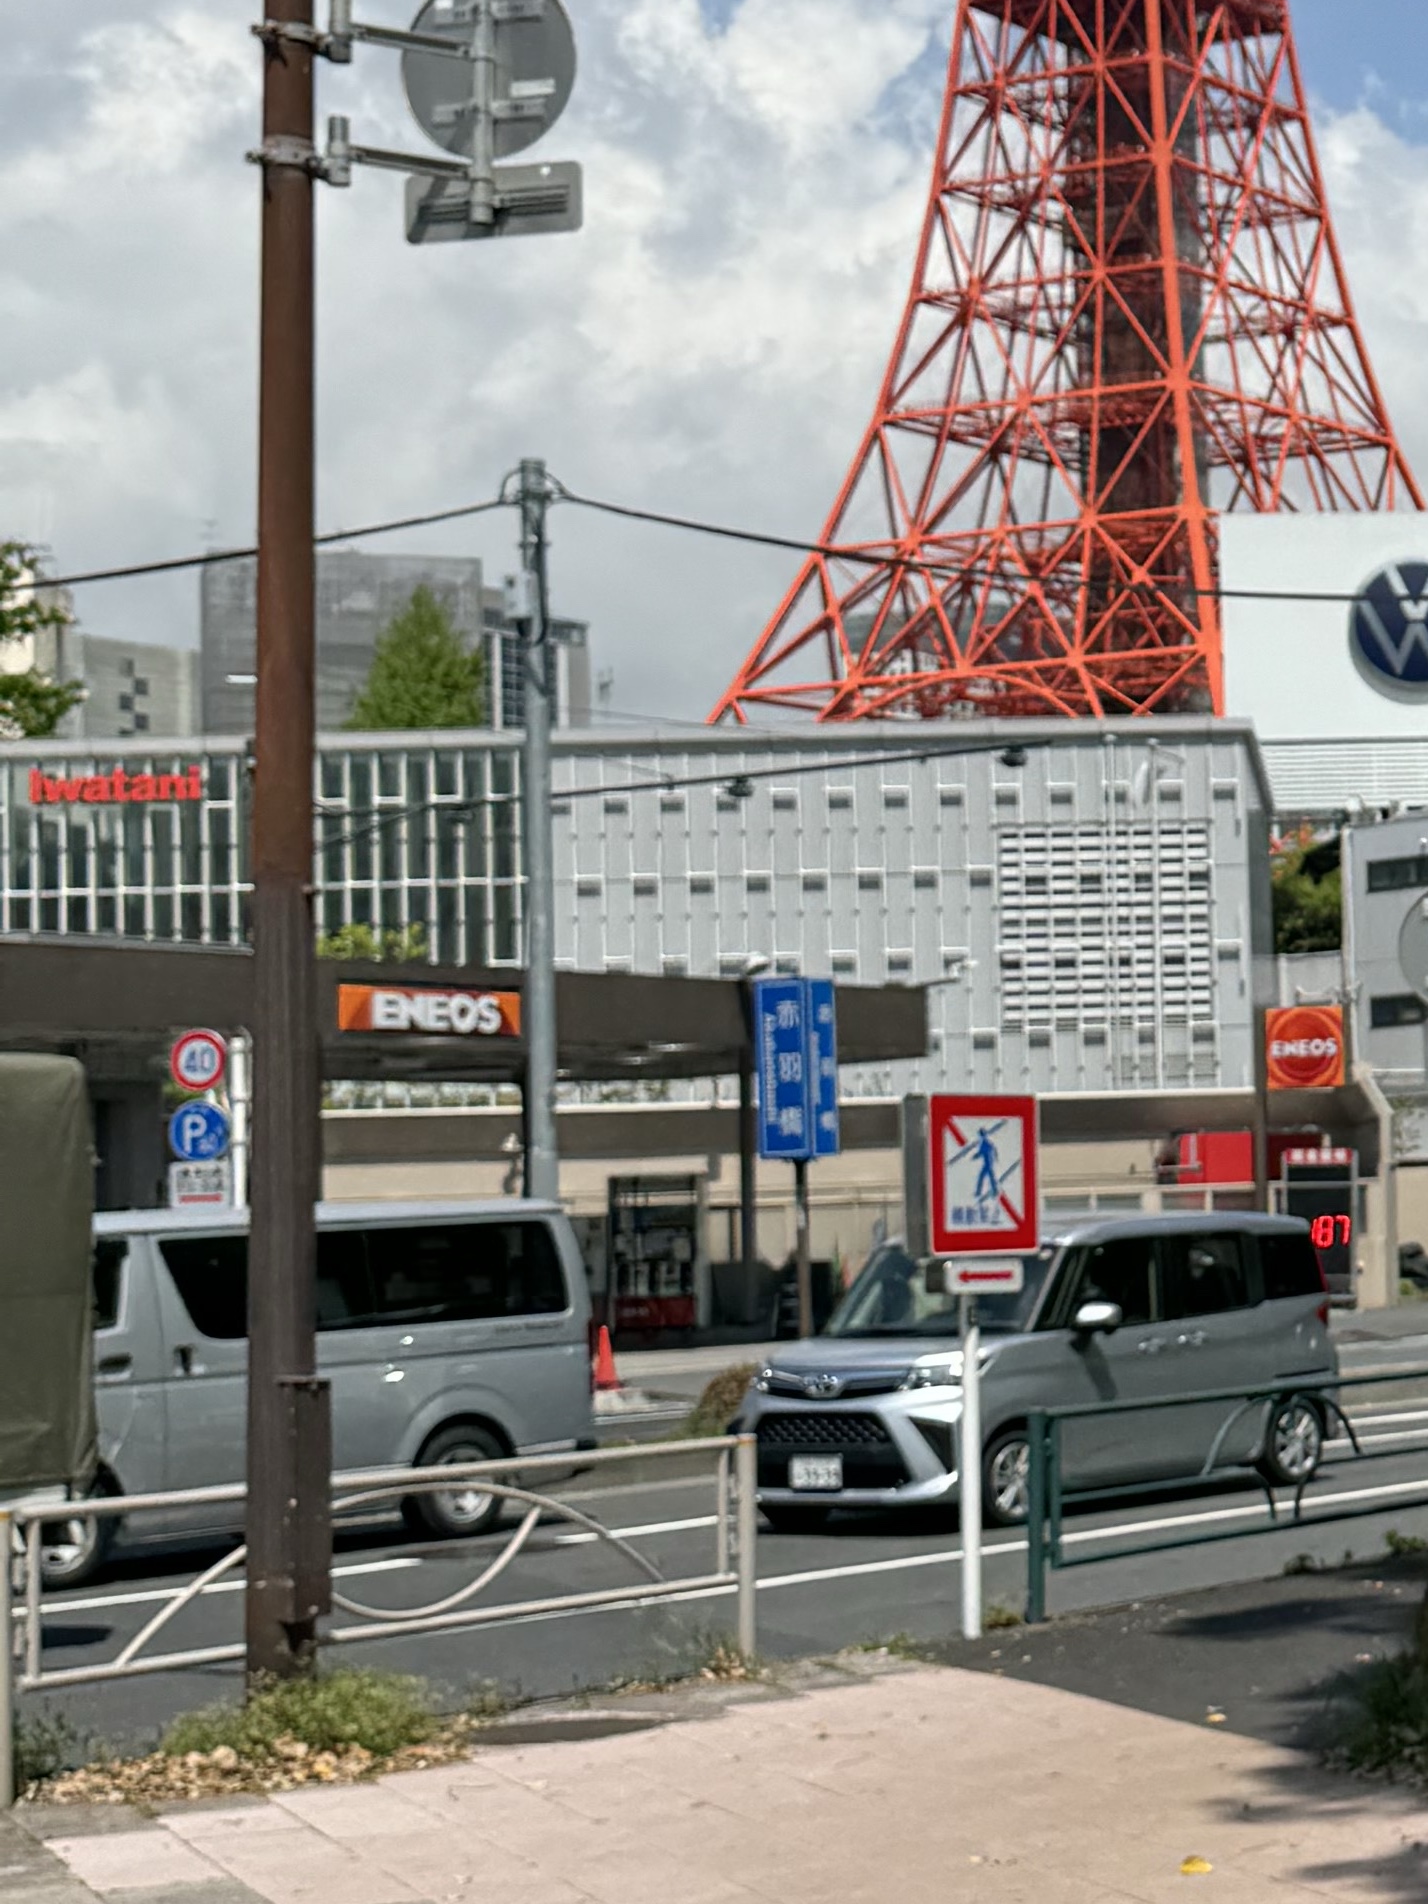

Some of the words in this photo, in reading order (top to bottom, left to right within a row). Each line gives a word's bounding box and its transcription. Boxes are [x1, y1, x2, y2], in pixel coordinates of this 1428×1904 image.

[29, 765, 200, 804] Iwatani
[372, 991, 502, 1034] ENEOS
[184, 1046, 216, 1073] 40
[776, 1000, 802, 1136] 赤羽橋
[1270, 1037, 1338, 1059] ENEOS
[182, 1113, 207, 1154] P
